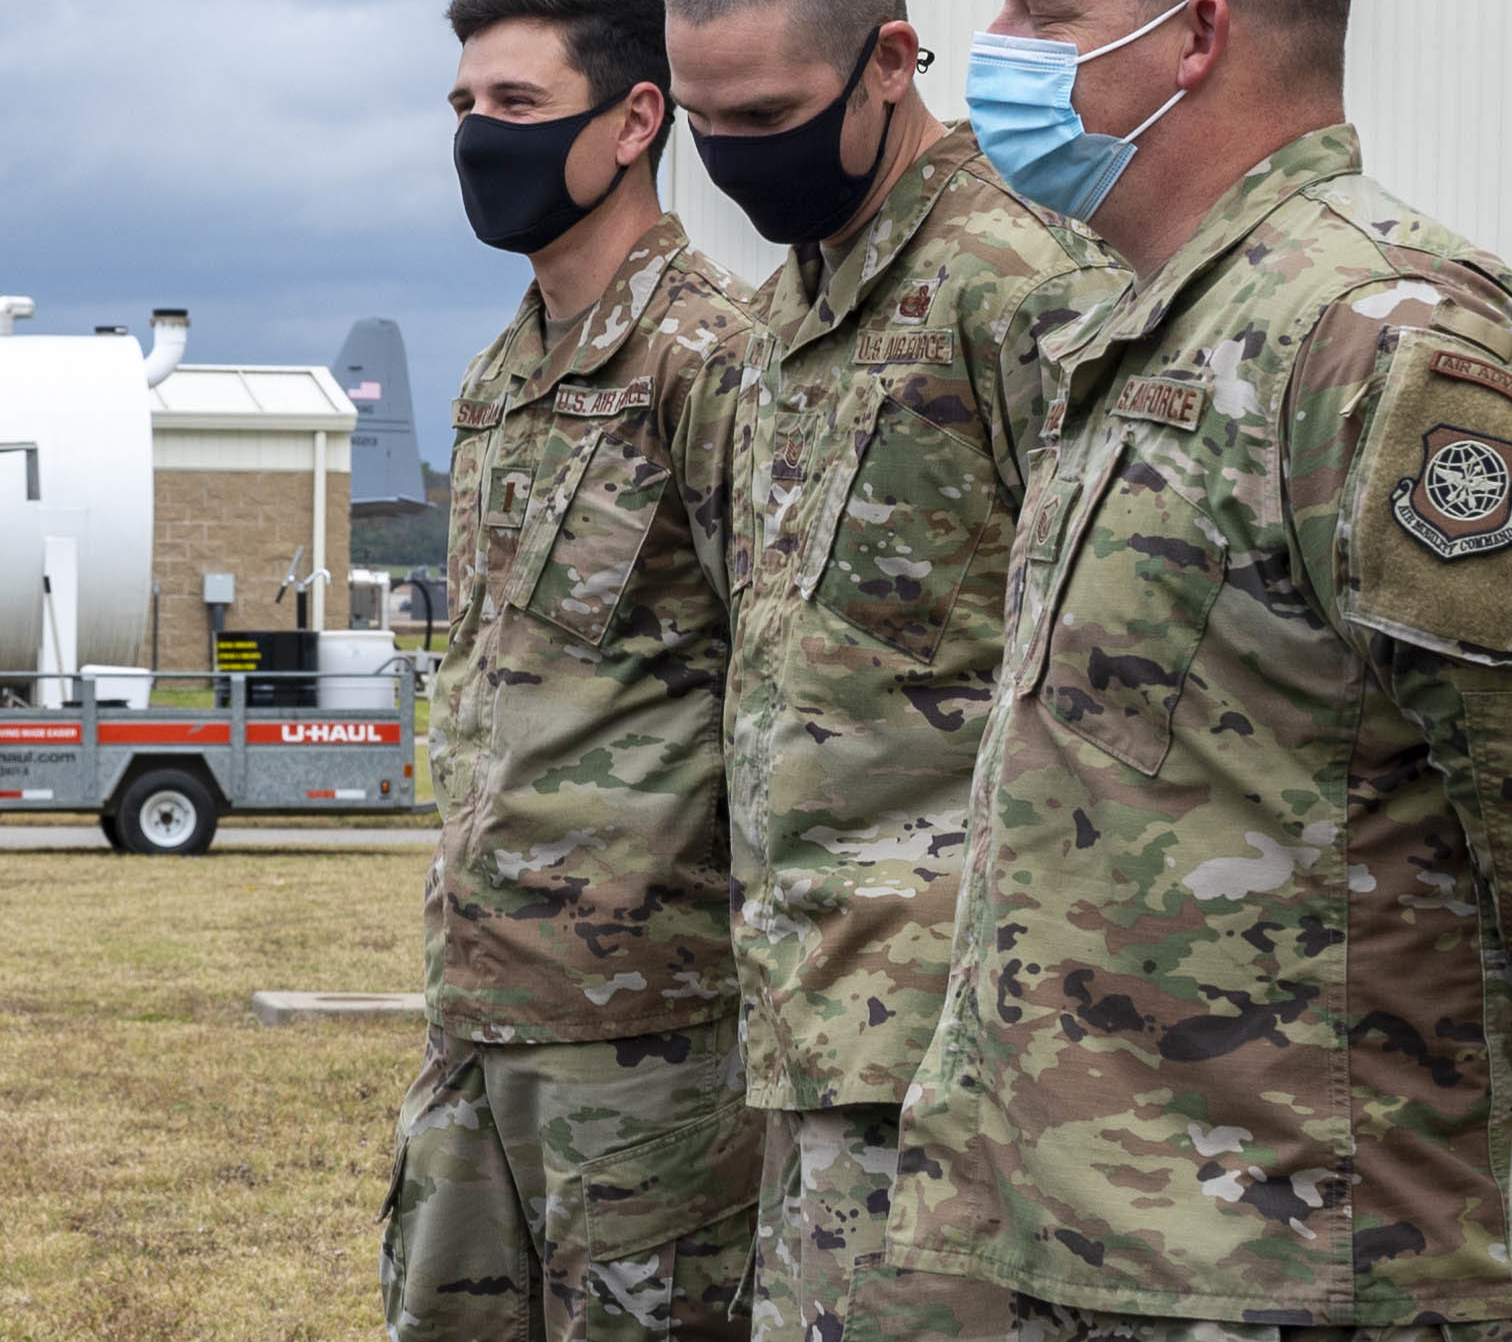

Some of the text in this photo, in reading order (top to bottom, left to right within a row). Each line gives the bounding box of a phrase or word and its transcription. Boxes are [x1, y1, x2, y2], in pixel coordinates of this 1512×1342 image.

[1441, 358, 1472, 374] AIR
[592, 393, 614, 414] AIR
[1398, 505, 1415, 525] AIR
[282, 724, 382, 742] U-HAUL
